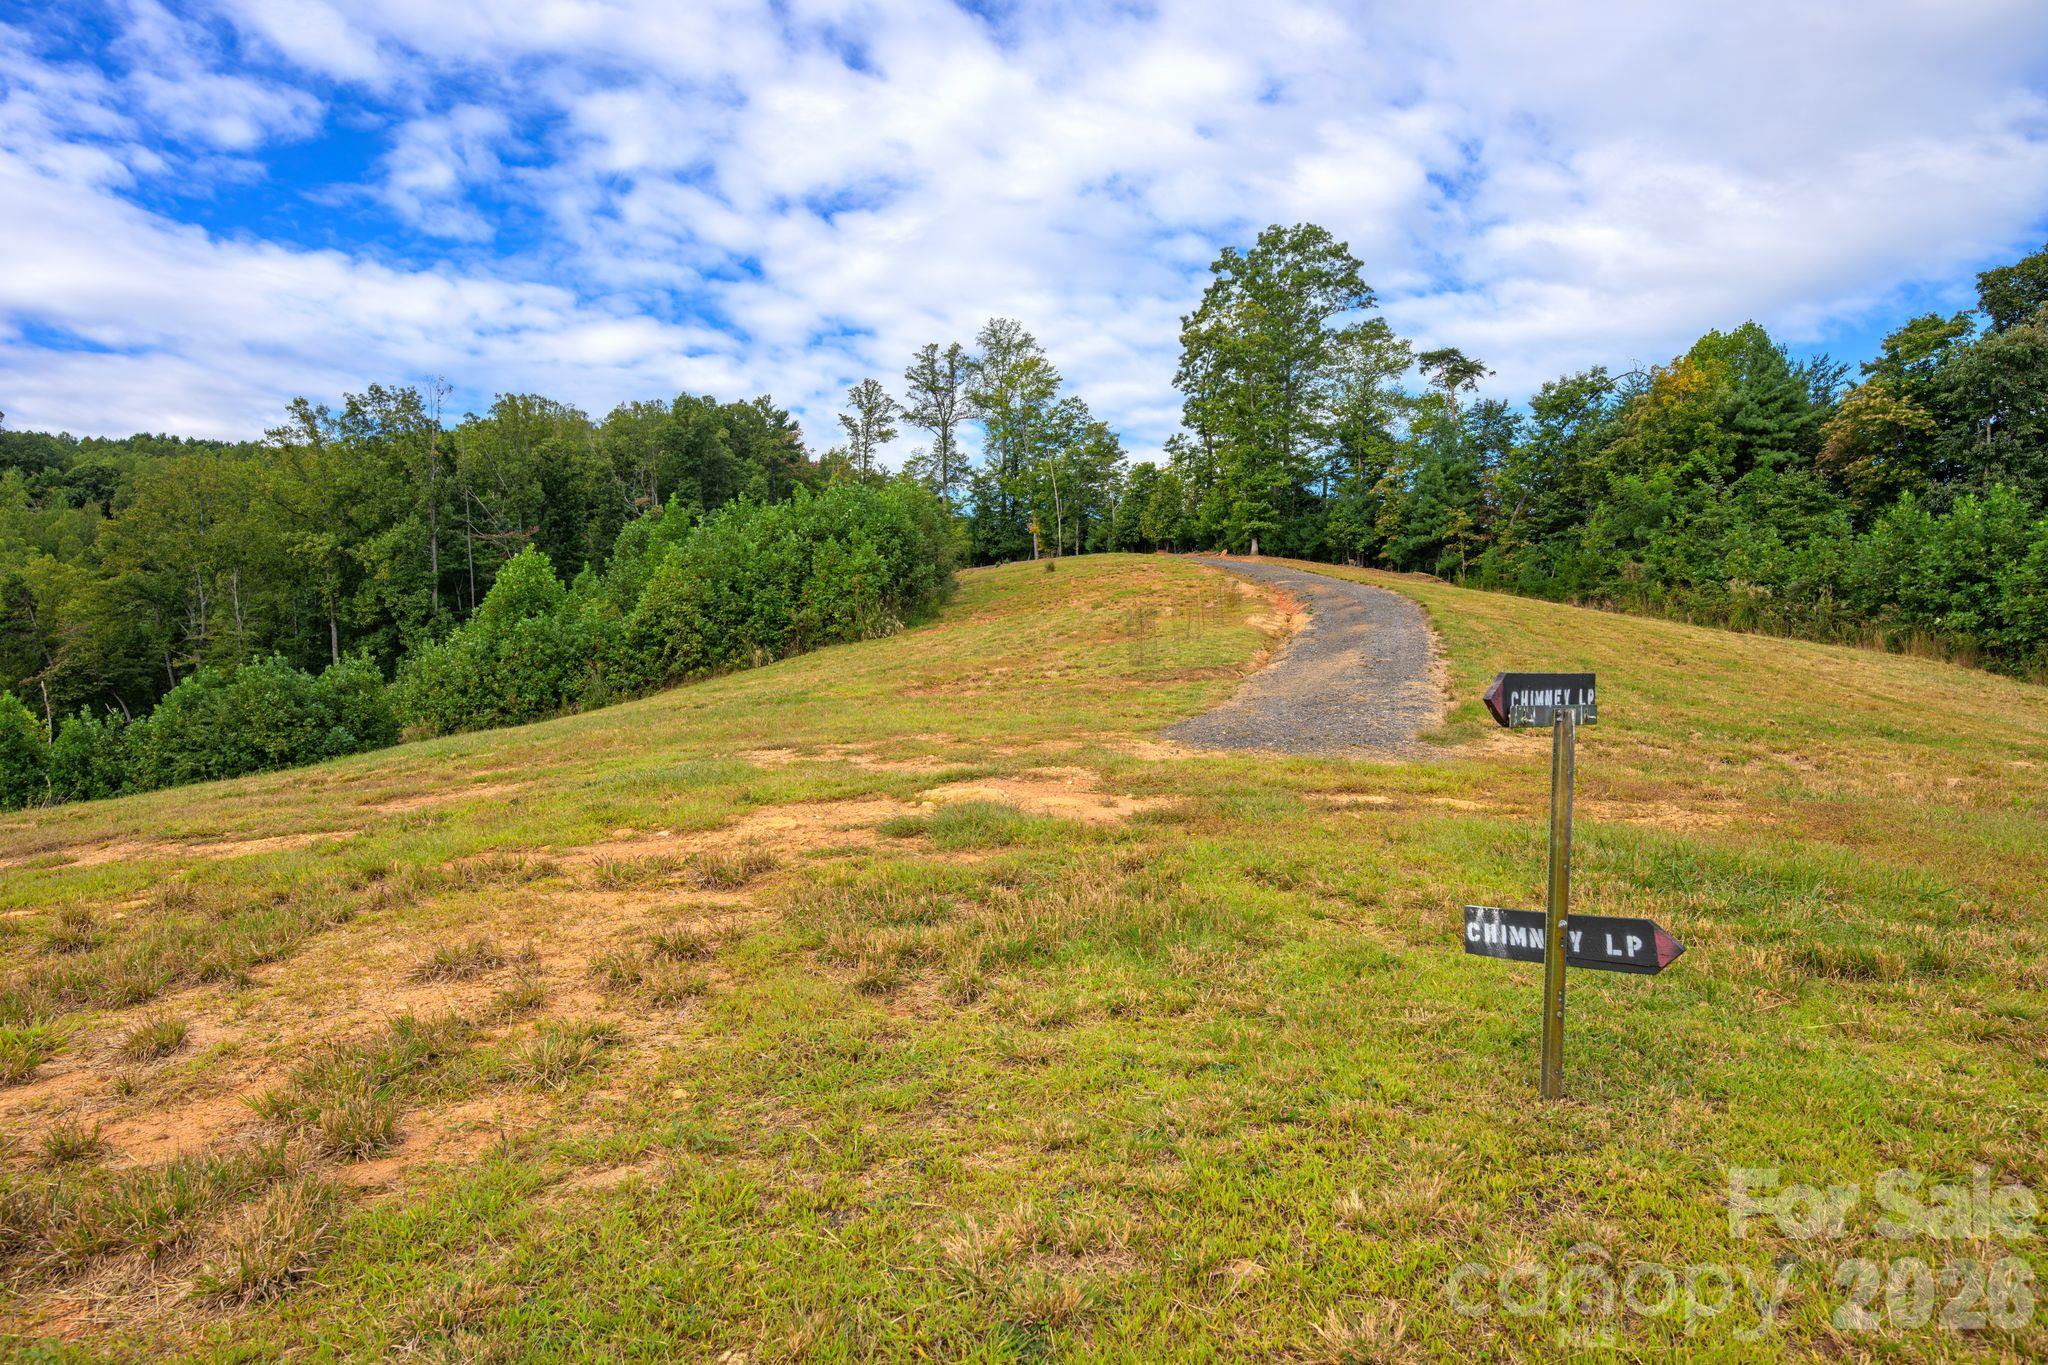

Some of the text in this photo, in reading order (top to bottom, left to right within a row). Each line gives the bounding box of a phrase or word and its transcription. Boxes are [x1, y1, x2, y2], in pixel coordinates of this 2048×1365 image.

[1511, 688, 1595, 706] CHIMNEY LP
[1466, 922, 1643, 957] CHIMNY LP
